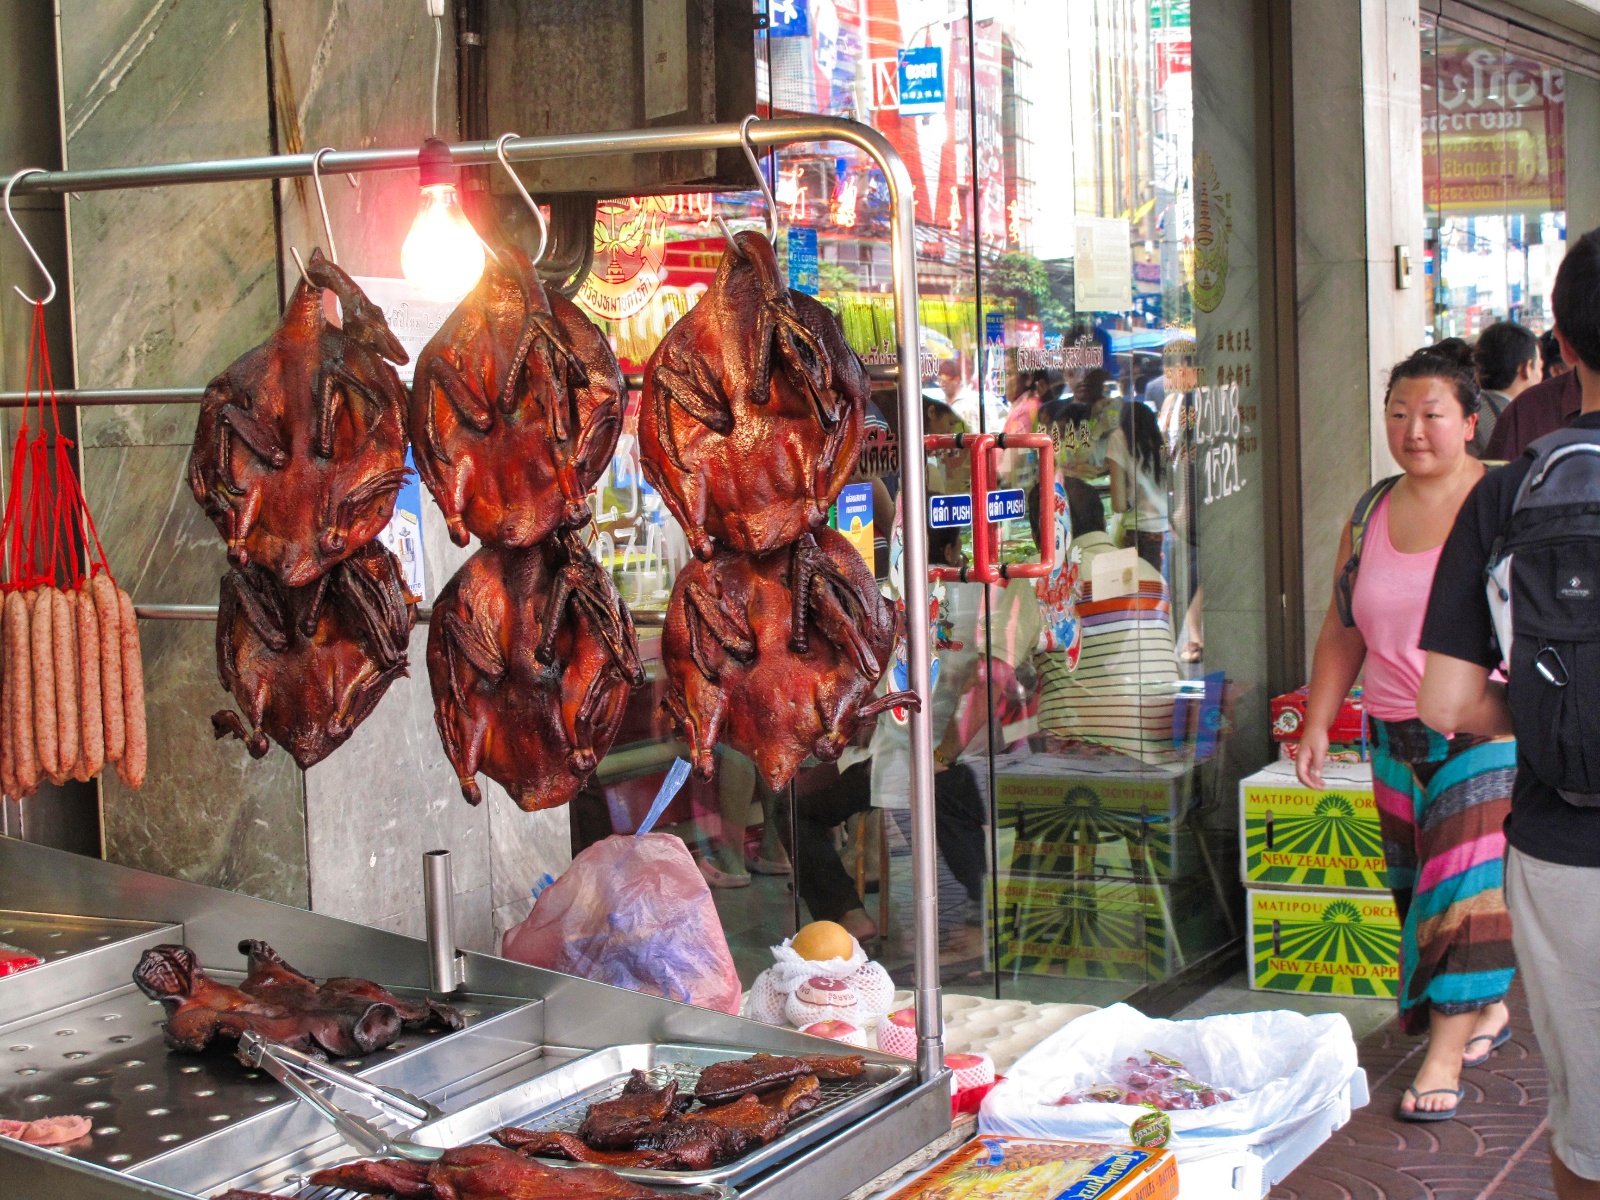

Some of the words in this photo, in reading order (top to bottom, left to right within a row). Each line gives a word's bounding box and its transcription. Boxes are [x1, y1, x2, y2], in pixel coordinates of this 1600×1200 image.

[789, 251, 817, 261] Welcome
[580, 277, 652, 312] ครื่องหมายการค้า
[933, 499, 949, 522] ผลัก
[952, 505, 971, 520] PUSH
[989, 494, 1004, 516] ผลัก
[1006, 499, 1024, 515] PUSH
[1250, 794, 1314, 806] MATIPOU
[1262, 853, 1293, 866] NEW
[1297, 855, 1359, 869] ZEALAND
[1258, 901, 1322, 913] MATIPOU
[1362, 906, 1399, 917] ORCH
[1270, 959, 1300, 972] NEW
[1304, 962, 1367, 977] ZEALAND
[1371, 965, 1399, 978] APP
[1103, 1152, 1139, 1181] JORDAN
[1078, 1174, 1111, 1200] RIVER
